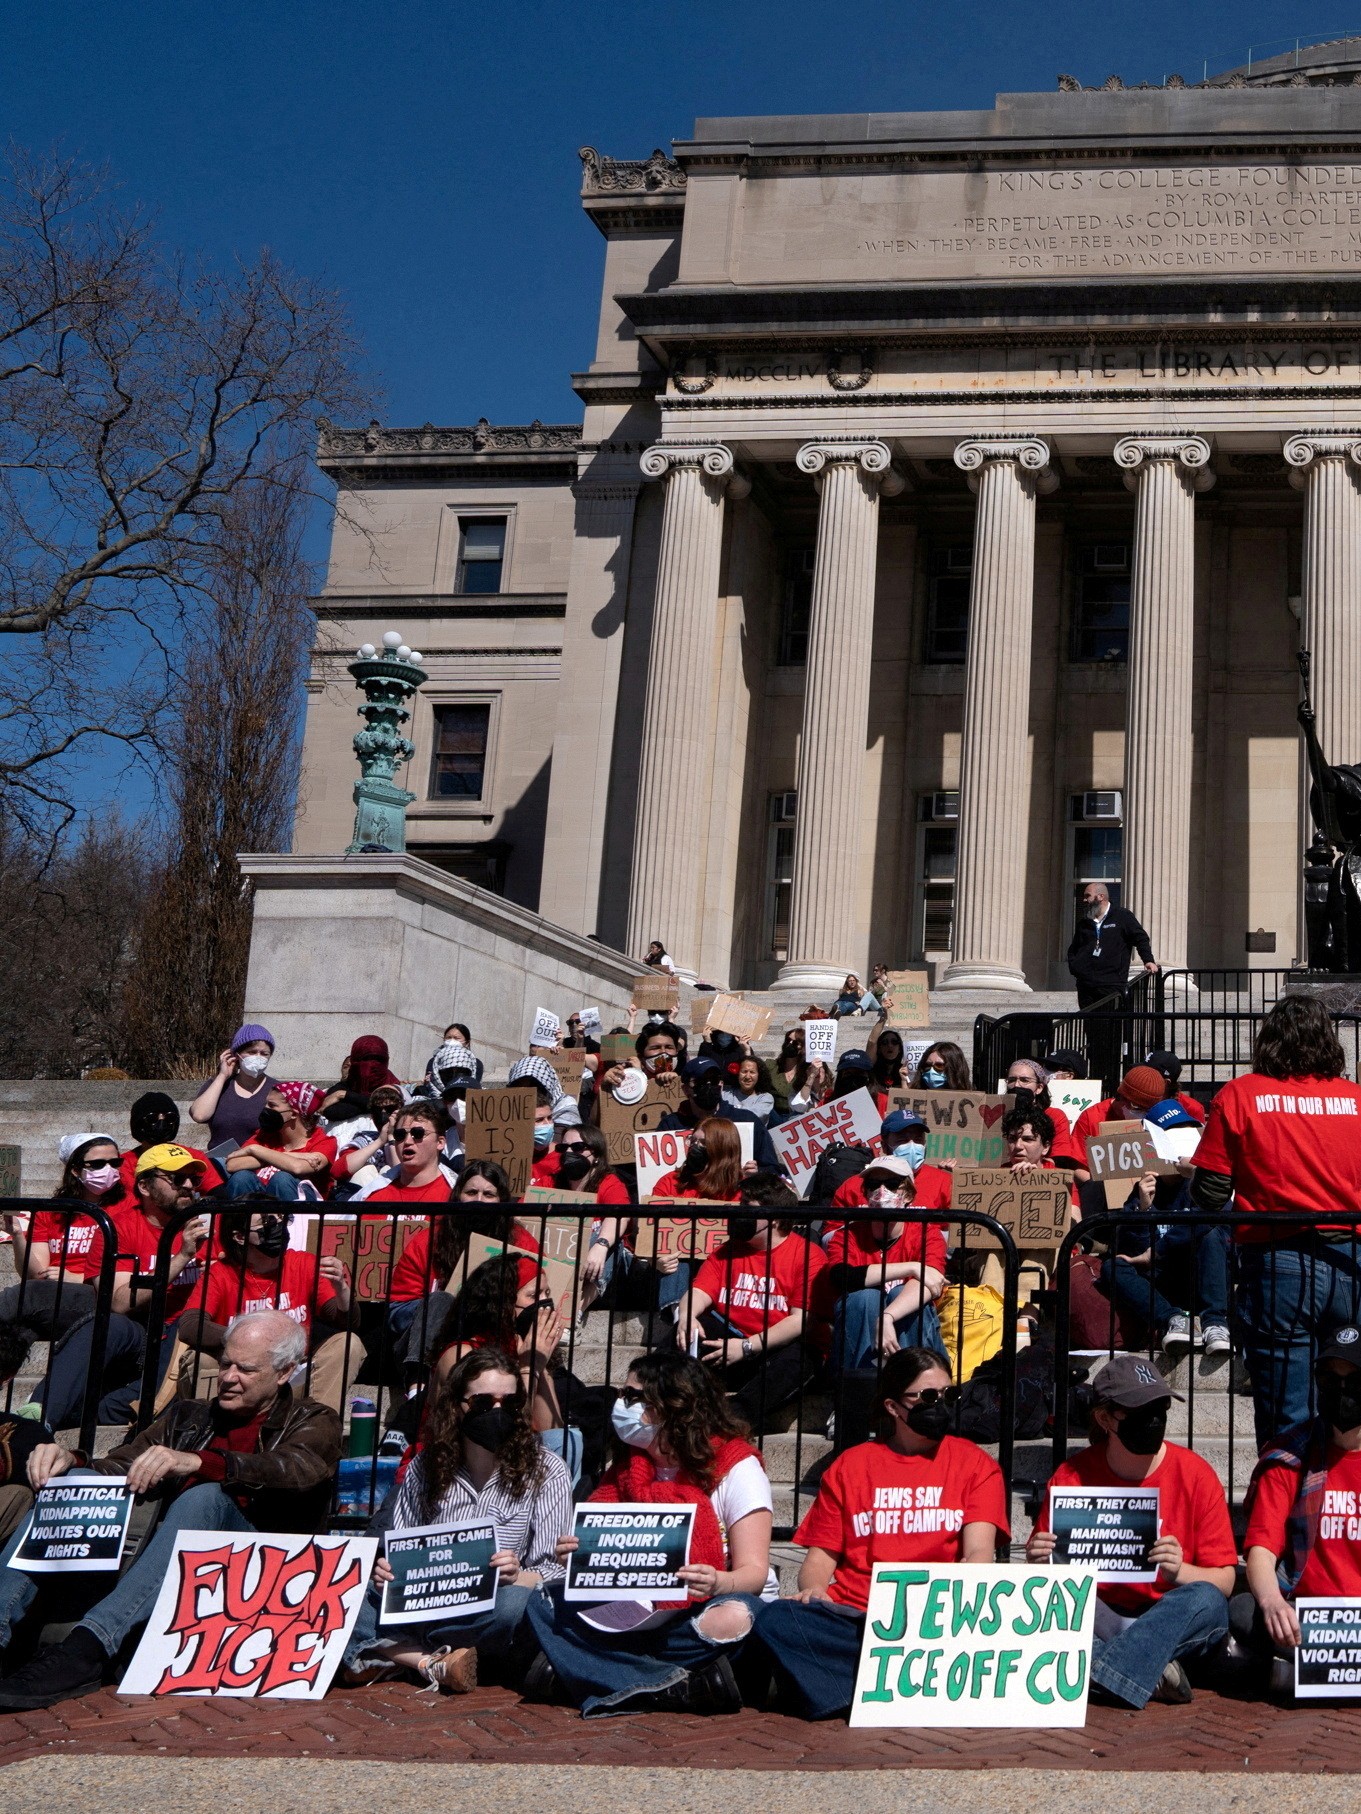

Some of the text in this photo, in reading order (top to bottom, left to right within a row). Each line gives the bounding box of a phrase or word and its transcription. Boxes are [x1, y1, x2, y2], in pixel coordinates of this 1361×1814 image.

[999, 171, 1084, 192] KING'S
[1097, 167, 1221, 190] COLLEGE
[1165, 193, 1190, 207] BY
[1201, 192, 1265, 206] ROYAL
[963, 215, 1102, 233] PERPETUATED
[1112, 214, 1135, 230] AS
[1146, 210, 1271, 229] COLUMBIA
[865, 240, 920, 253] WHEN
[929, 239, 978, 252] THEY
[987, 237, 1058, 251] BECAME
[1070, 235, 1112, 248] FREE
[1124, 235, 1161, 248] AND
[1175, 232, 1304, 246] INDEPENDENT
[725, 364, 820, 381] MDCCLIV
[1050, 354, 1117, 380] THE
[1138, 350, 1288, 378] LIBRARY
[1302, 350, 1353, 376] OF
[809, 1024, 834, 1032] HANDS
[809, 1031, 834, 1041] OFF
[809, 1041, 832, 1051] OUR
[470, 1093, 534, 1124] NO ONE
[1061, 1094, 1092, 1112] say
[1255, 1094, 1358, 1116] NOT IN OUR NAME
[780, 1099, 853, 1144] JEWS
[485, 1127, 516, 1155] IS
[1090, 1143, 1144, 1175] PIGS
[957, 1190, 1068, 1240] ICE!
[37, 1486, 127, 1503] ICE POLITICAL
[873, 1485, 944, 1510] JEWS SAY
[38, 1505, 118, 1521] KIDNAPPING
[581, 1514, 687, 1529] FREEDOM OF
[31, 1523, 122, 1540] VIOLATES OUR
[852, 1508, 965, 1539] ICE OFF CAMPUS
[389, 1528, 495, 1554] FIRST, THEY CAME
[597, 1533, 665, 1549] INQUIRY
[44, 1543, 91, 1559] RIGHTS
[428, 1549, 454, 1562] FOR
[588, 1552, 669, 1568] REQUIRES
[406, 1563, 481, 1581] MAHMOUD...
[574, 1572, 680, 1587] FREE SPEECH
[163, 1537, 362, 1636] FUCK
[403, 1575, 484, 1597] BUT I WASN'T
[404, 1593, 479, 1611] MAHMOUD...
[870, 1569, 1095, 1642] JEWS SAY
[1302, 1609, 1329, 1624] ICE
[151, 1614, 333, 1697] ICE
[861, 1645, 1087, 1706] ICE OFF CU
